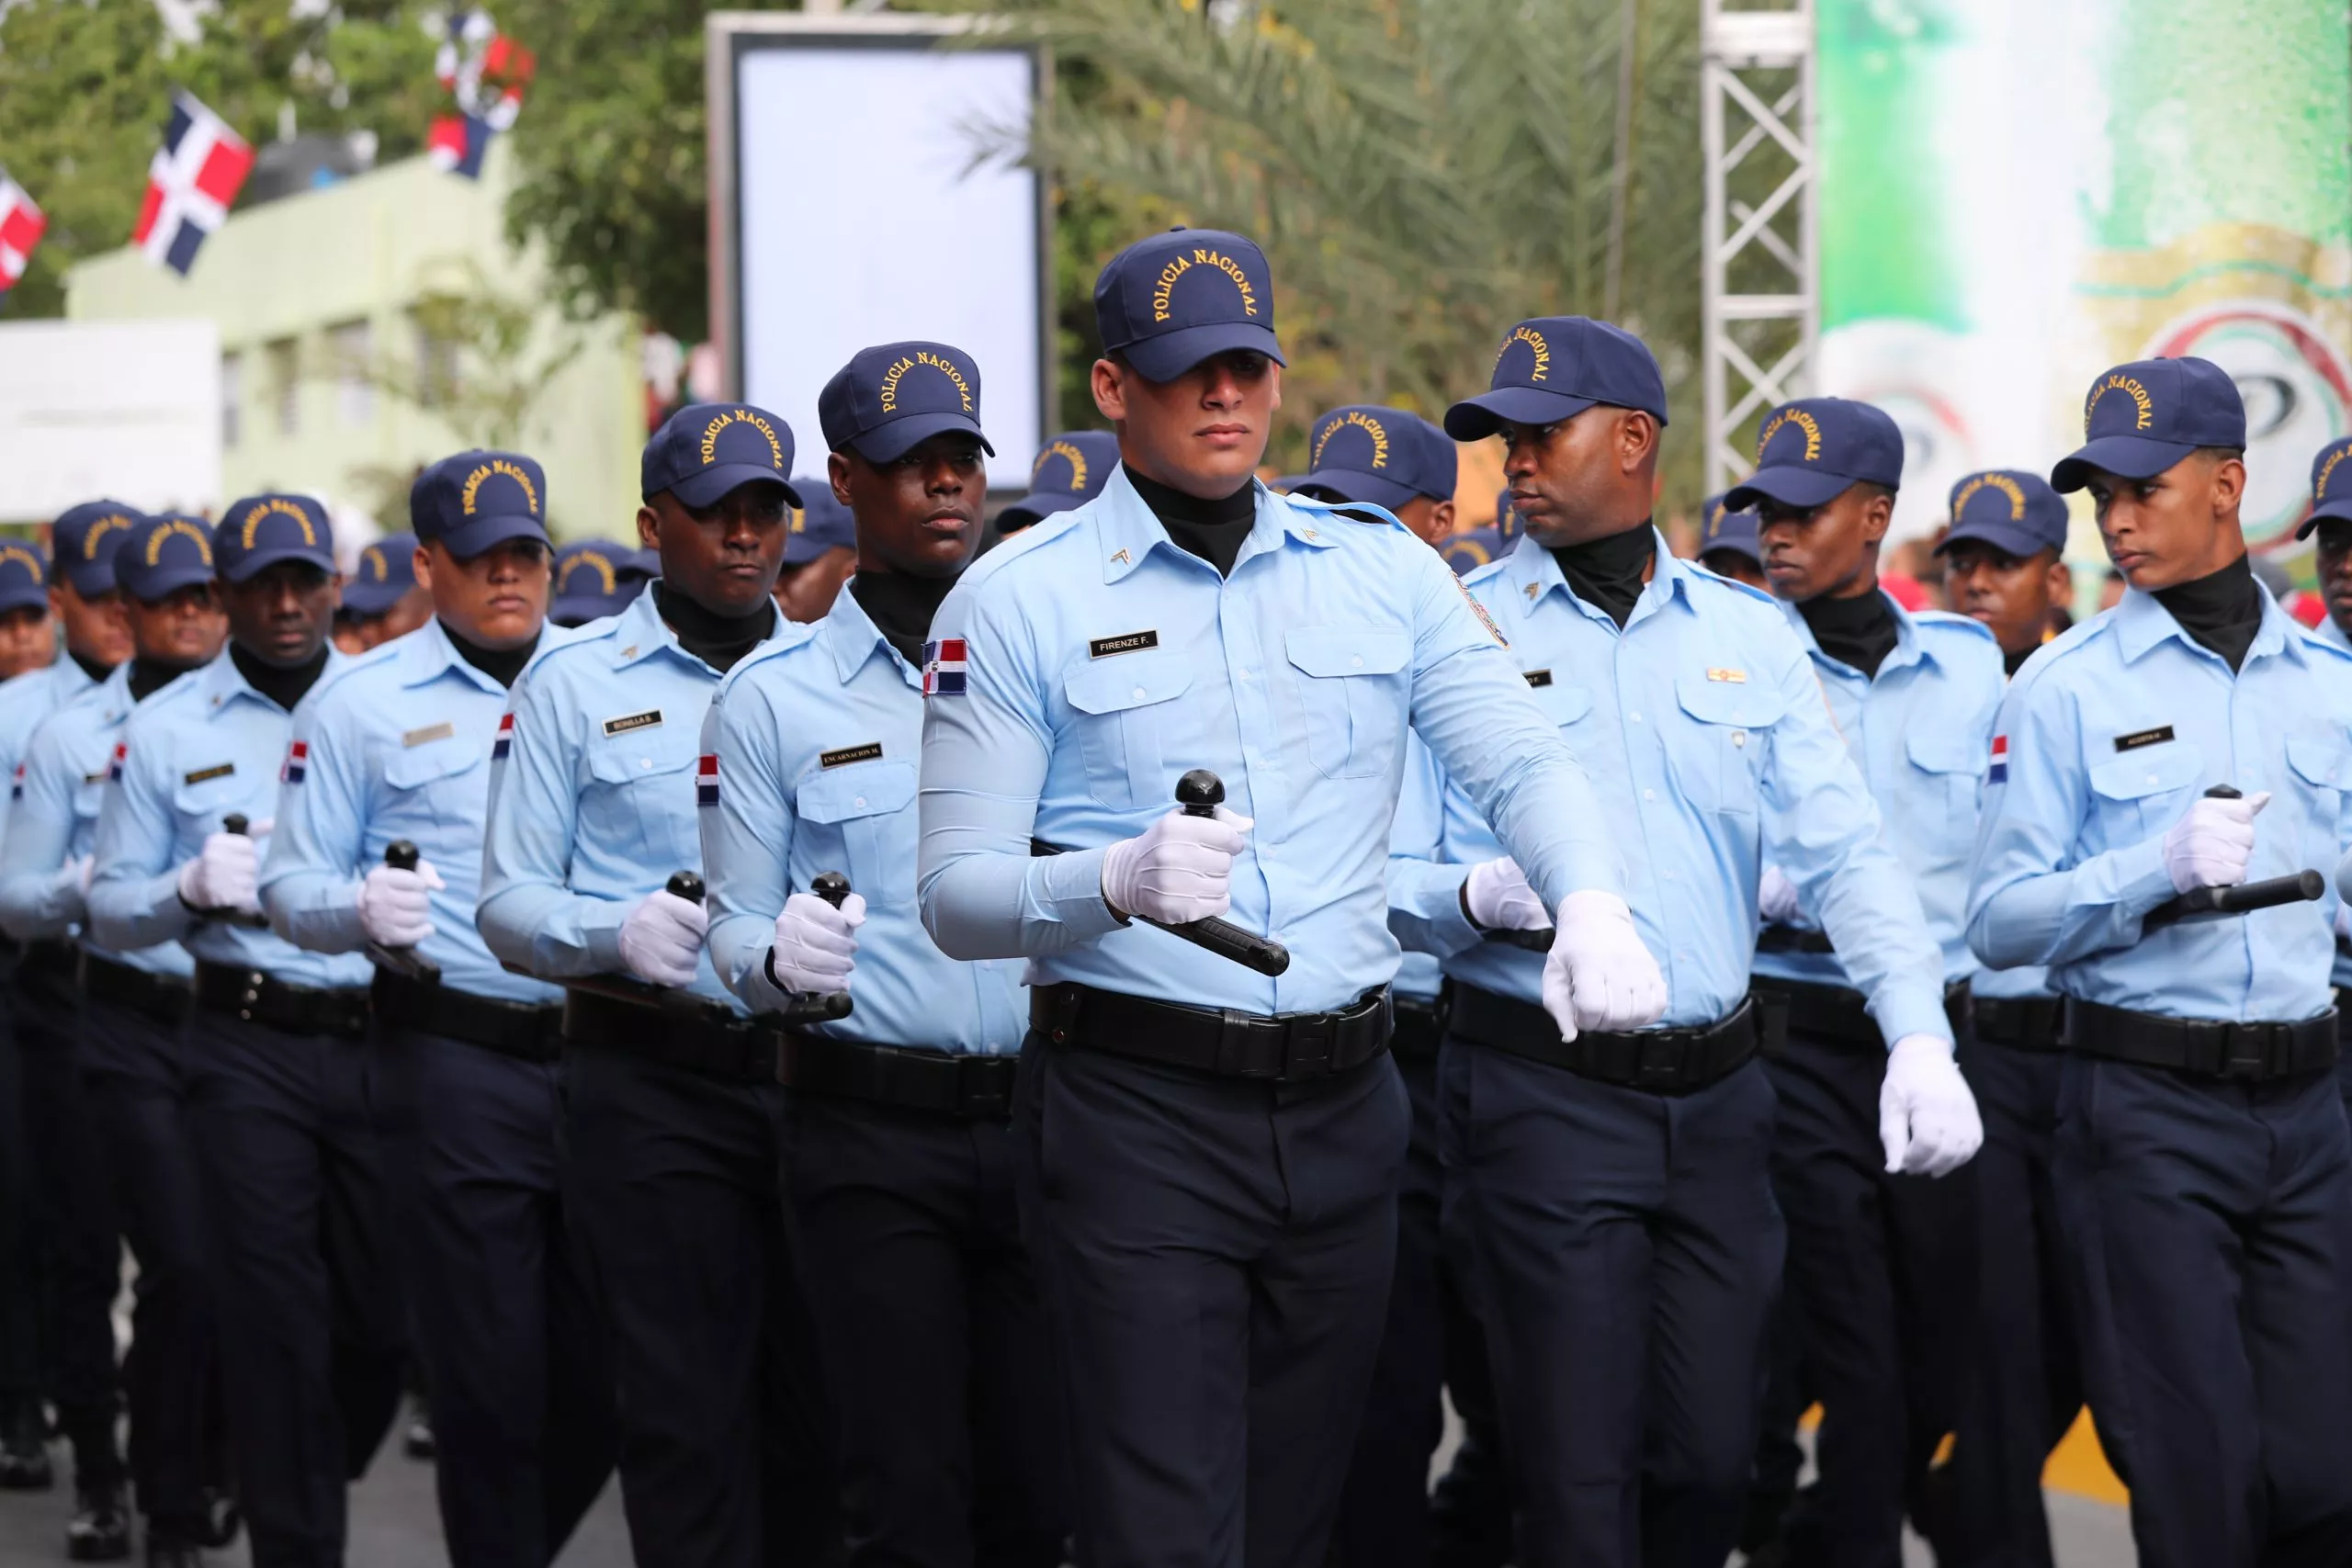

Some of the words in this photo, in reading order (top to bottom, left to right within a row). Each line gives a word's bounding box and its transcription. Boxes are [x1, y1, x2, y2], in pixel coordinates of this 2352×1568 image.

[1153, 255, 1192, 322] POLICIA
[1193, 249, 1257, 316] NACIONAL
[1514, 327, 1550, 381] NACIONAL
[881, 356, 915, 412] POLICIA
[916, 352, 974, 412] NACIONAL
[2108, 375, 2152, 430] NACIONAL
[701, 413, 733, 465] POLICIA
[734, 410, 783, 468] NACIONAL
[1347, 412, 1389, 468] NACIONAL
[1785, 408, 1822, 461] NACIONAL
[1100, 637, 1138, 651] FIRENZE
[1140, 637, 1149, 645] F.
[823, 750, 870, 763] ENCARNACION
